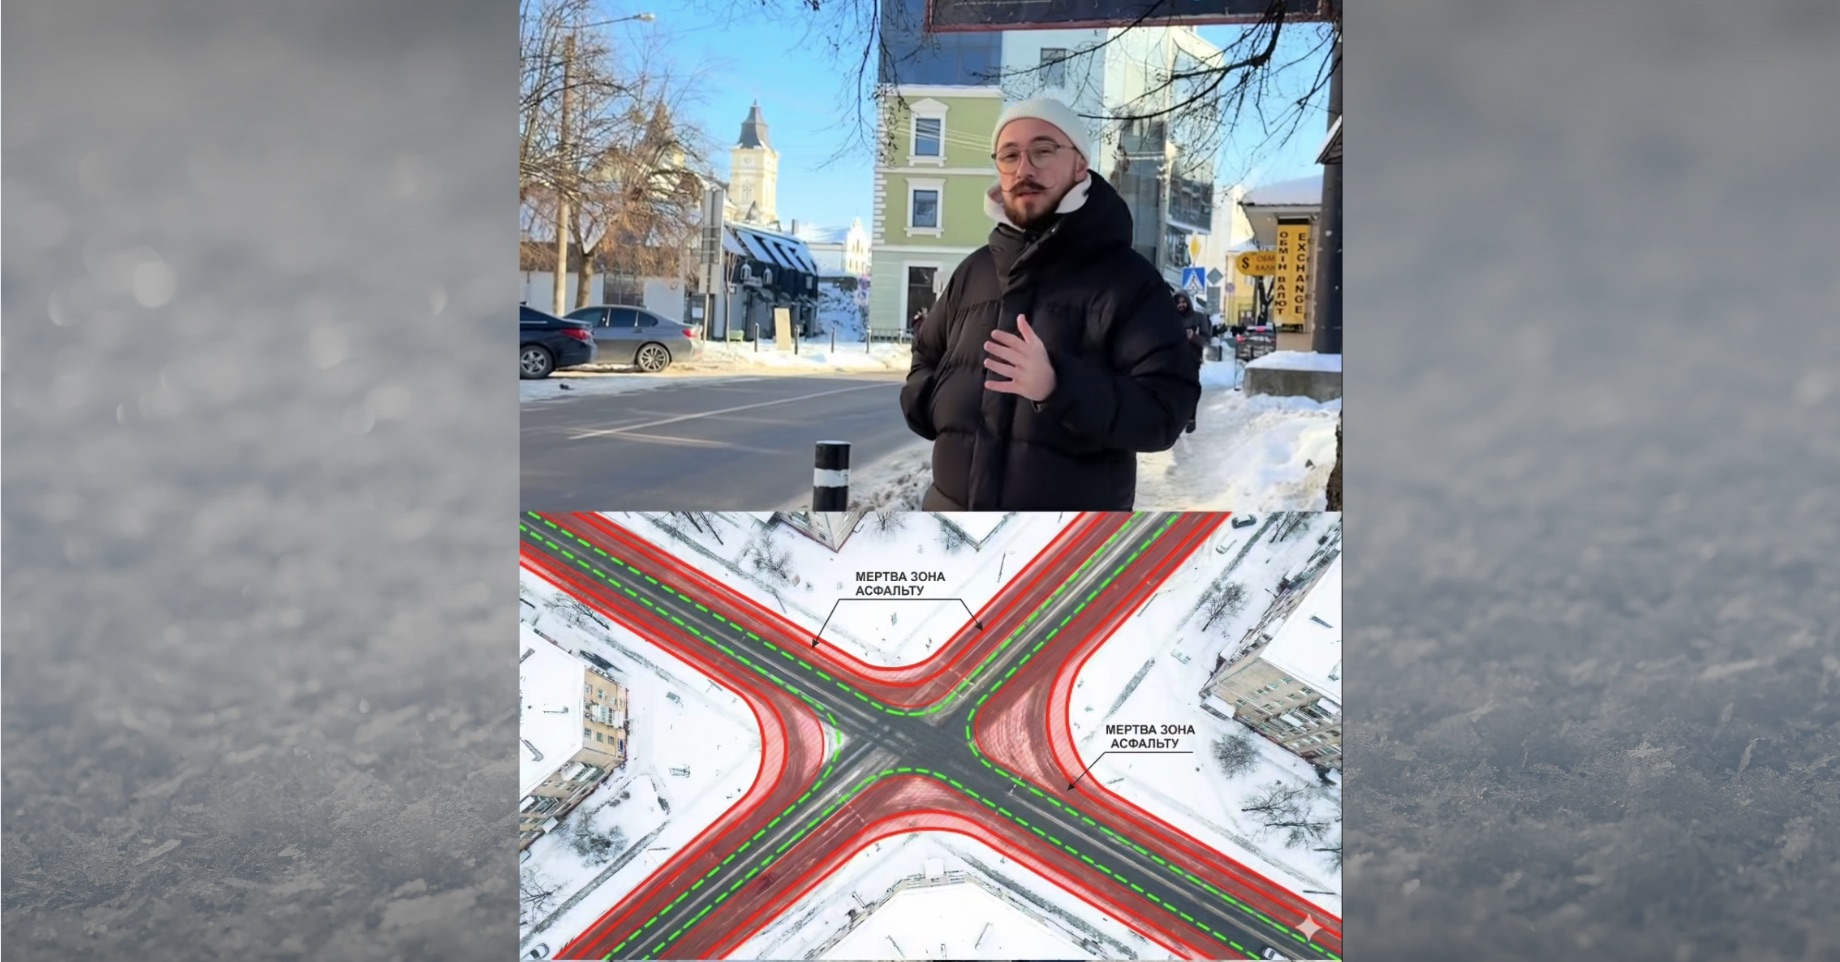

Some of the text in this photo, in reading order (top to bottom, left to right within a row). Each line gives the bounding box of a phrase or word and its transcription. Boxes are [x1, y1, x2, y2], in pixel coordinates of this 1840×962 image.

[1275, 231, 1289, 315] ОБМІН ВАЛЮТ
[1294, 232, 1307, 314] EXCHANGE
